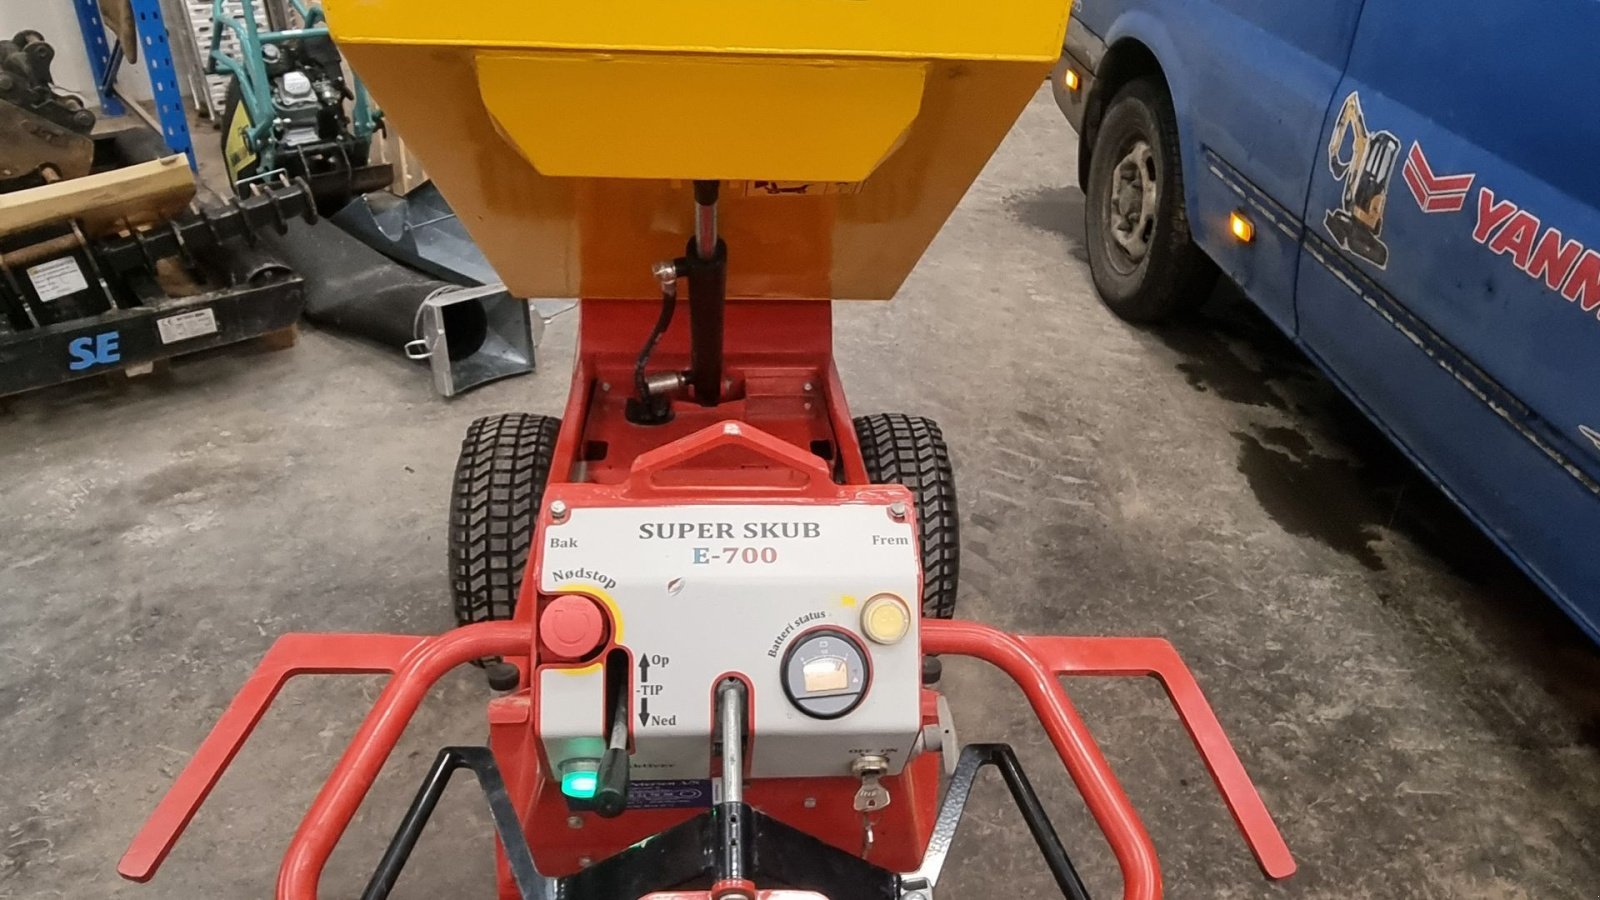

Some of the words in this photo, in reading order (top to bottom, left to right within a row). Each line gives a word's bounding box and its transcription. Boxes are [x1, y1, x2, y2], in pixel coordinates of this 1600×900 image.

[1472, 186, 1600, 321] YANN
[68, 330, 121, 371] SE
[639, 522, 735, 540] SUPER
[743, 522, 821, 539] SKUB
[872, 534, 909, 546] Frem
[550, 537, 579, 549] Bak
[692, 547, 778, 565] E-700
[552, 567, 617, 590] Nødstop
[767, 621, 796, 658] Batteri
[794, 610, 826, 627] status
[651, 654, 670, 668] Op
[651, 714, 677, 727] Ned
